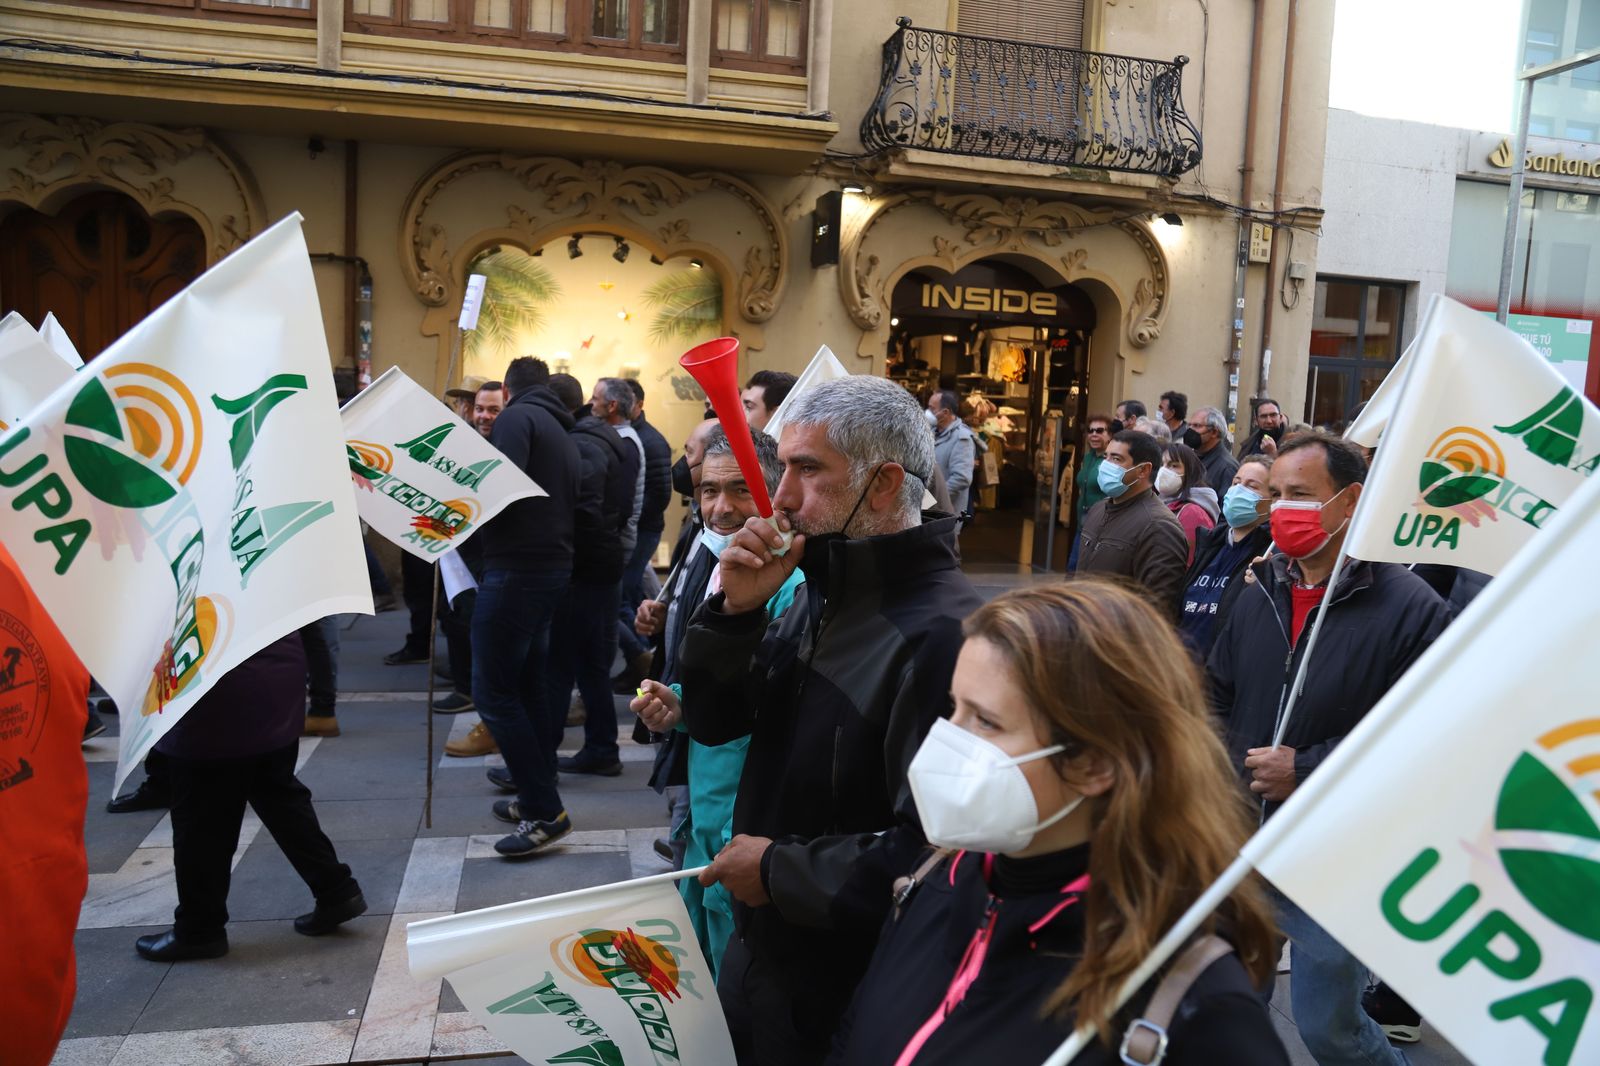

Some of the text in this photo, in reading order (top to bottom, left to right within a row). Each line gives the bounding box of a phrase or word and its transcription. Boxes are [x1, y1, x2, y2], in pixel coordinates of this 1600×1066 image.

[0, 426, 92, 576] UPA
[1393, 512, 1461, 550] UPA
[1380, 847, 1594, 1066] UPA
